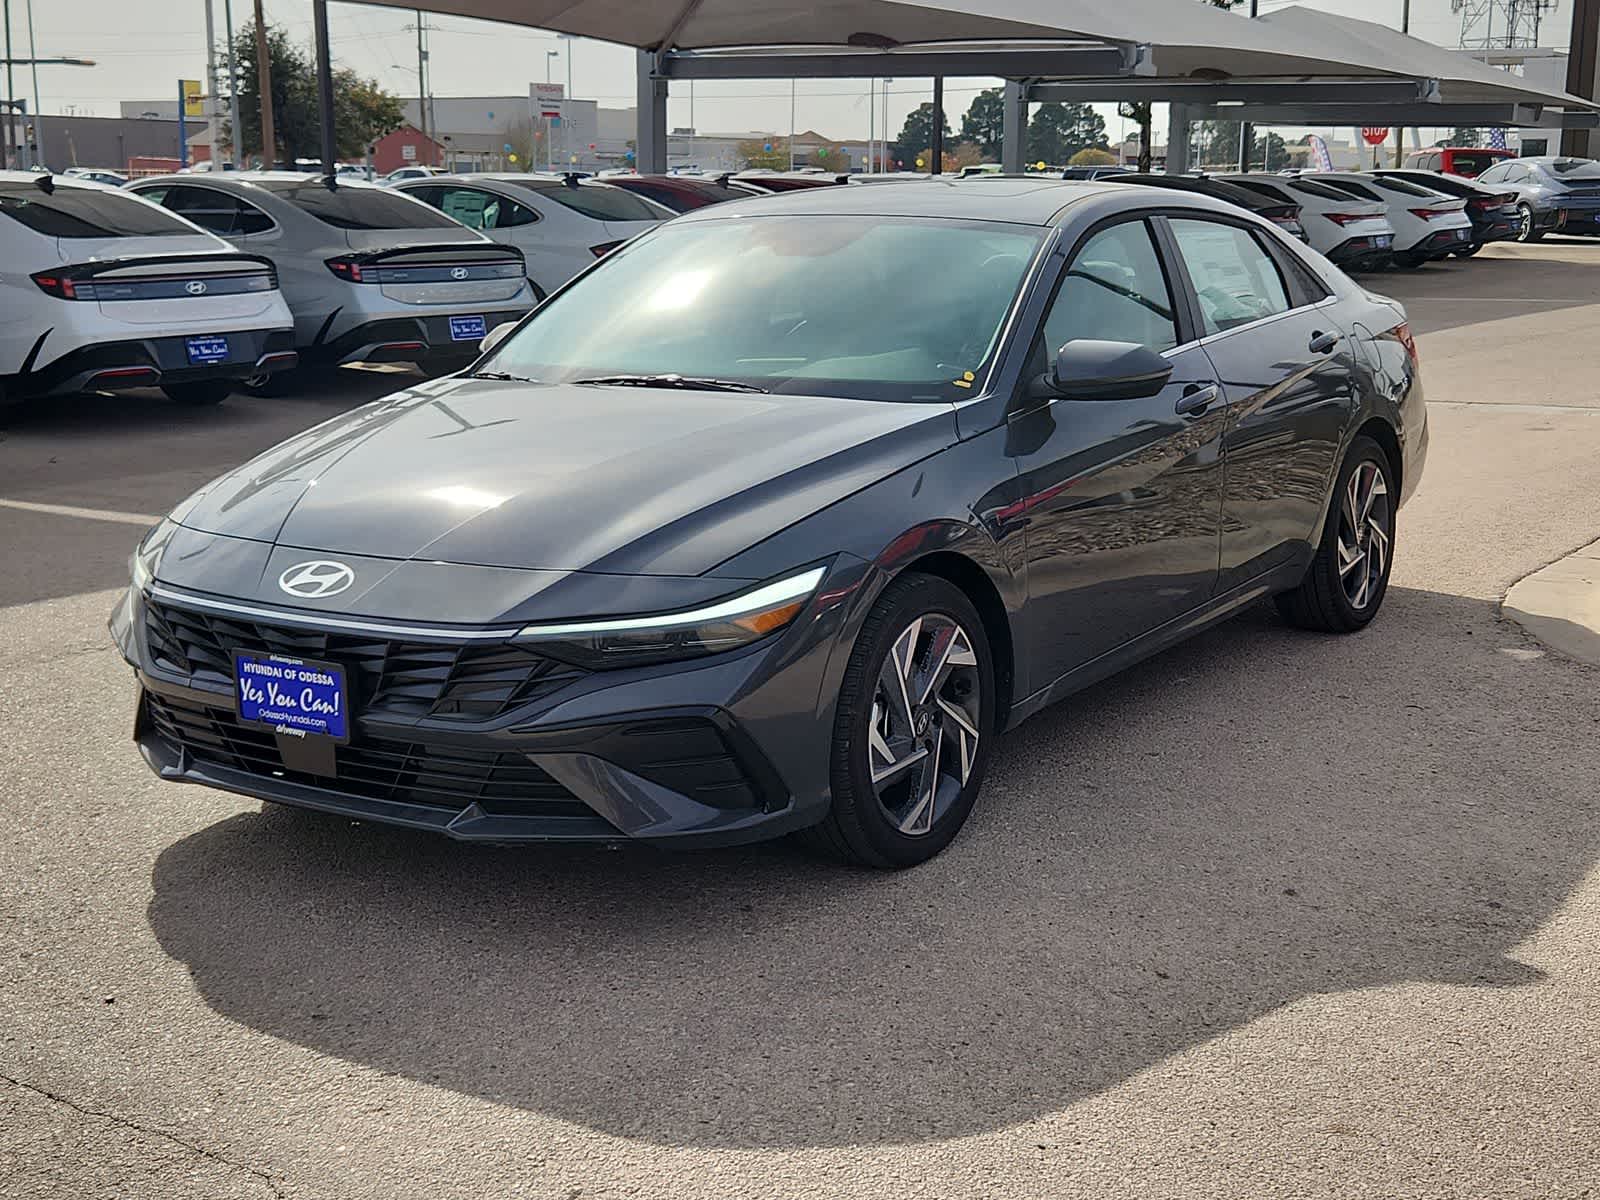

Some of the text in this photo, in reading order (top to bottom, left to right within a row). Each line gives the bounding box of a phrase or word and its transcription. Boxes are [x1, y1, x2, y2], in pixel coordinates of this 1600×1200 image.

[1363, 127, 1387, 137] STOP
[243, 662, 335, 686] HYUNDAI OF ODESSA
[240, 677, 340, 716] Yes You Can!
[258, 708, 327, 728] OdessaHyundai.com
[275, 724, 306, 738] driveway
